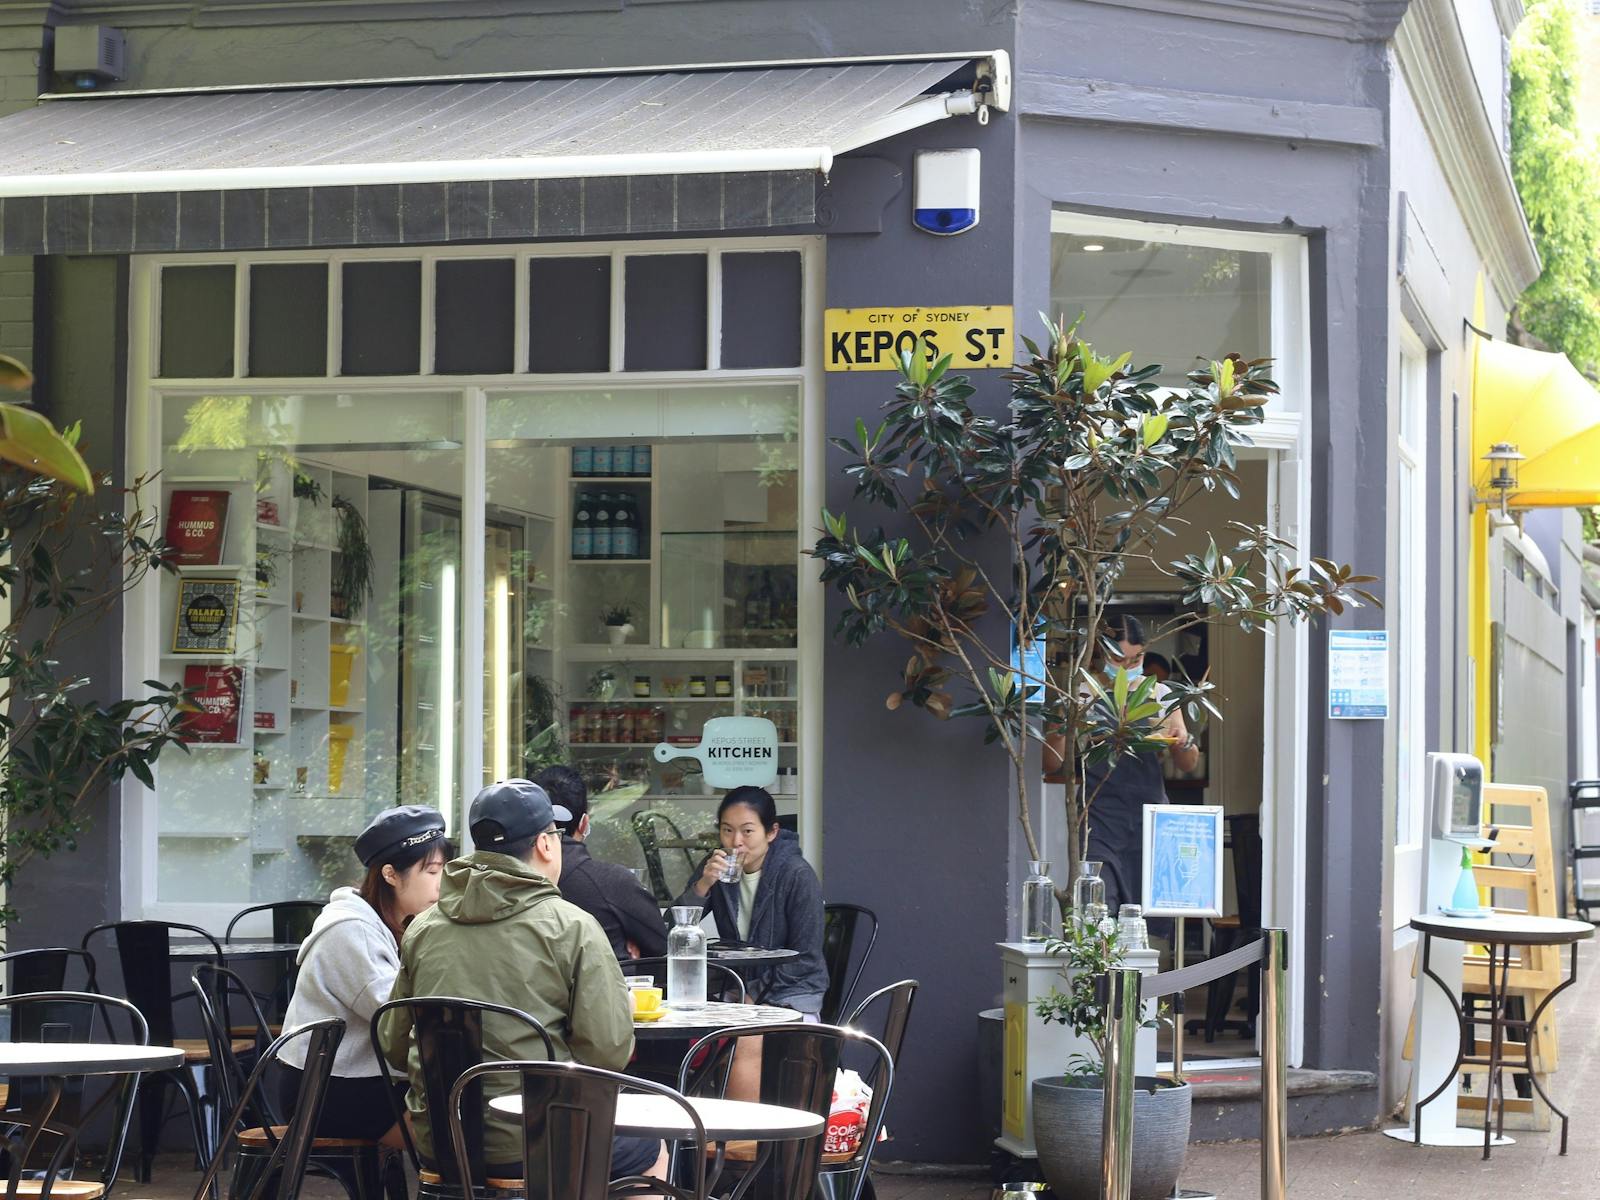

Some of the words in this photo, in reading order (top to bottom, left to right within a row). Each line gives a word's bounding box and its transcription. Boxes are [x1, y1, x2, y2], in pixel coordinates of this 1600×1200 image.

[868, 314, 895, 323] CITY
[902, 313, 919, 323] OF
[926, 312, 970, 322] SYDNEY
[831, 329, 940, 364] KEPOS
[178, 520, 215, 530] HUMMUS
[188, 608, 225, 617] FALAFEL
[738, 736, 766, 745] STREET
[708, 747, 771, 758] KITCHEN
[828, 1123, 857, 1137] cole
